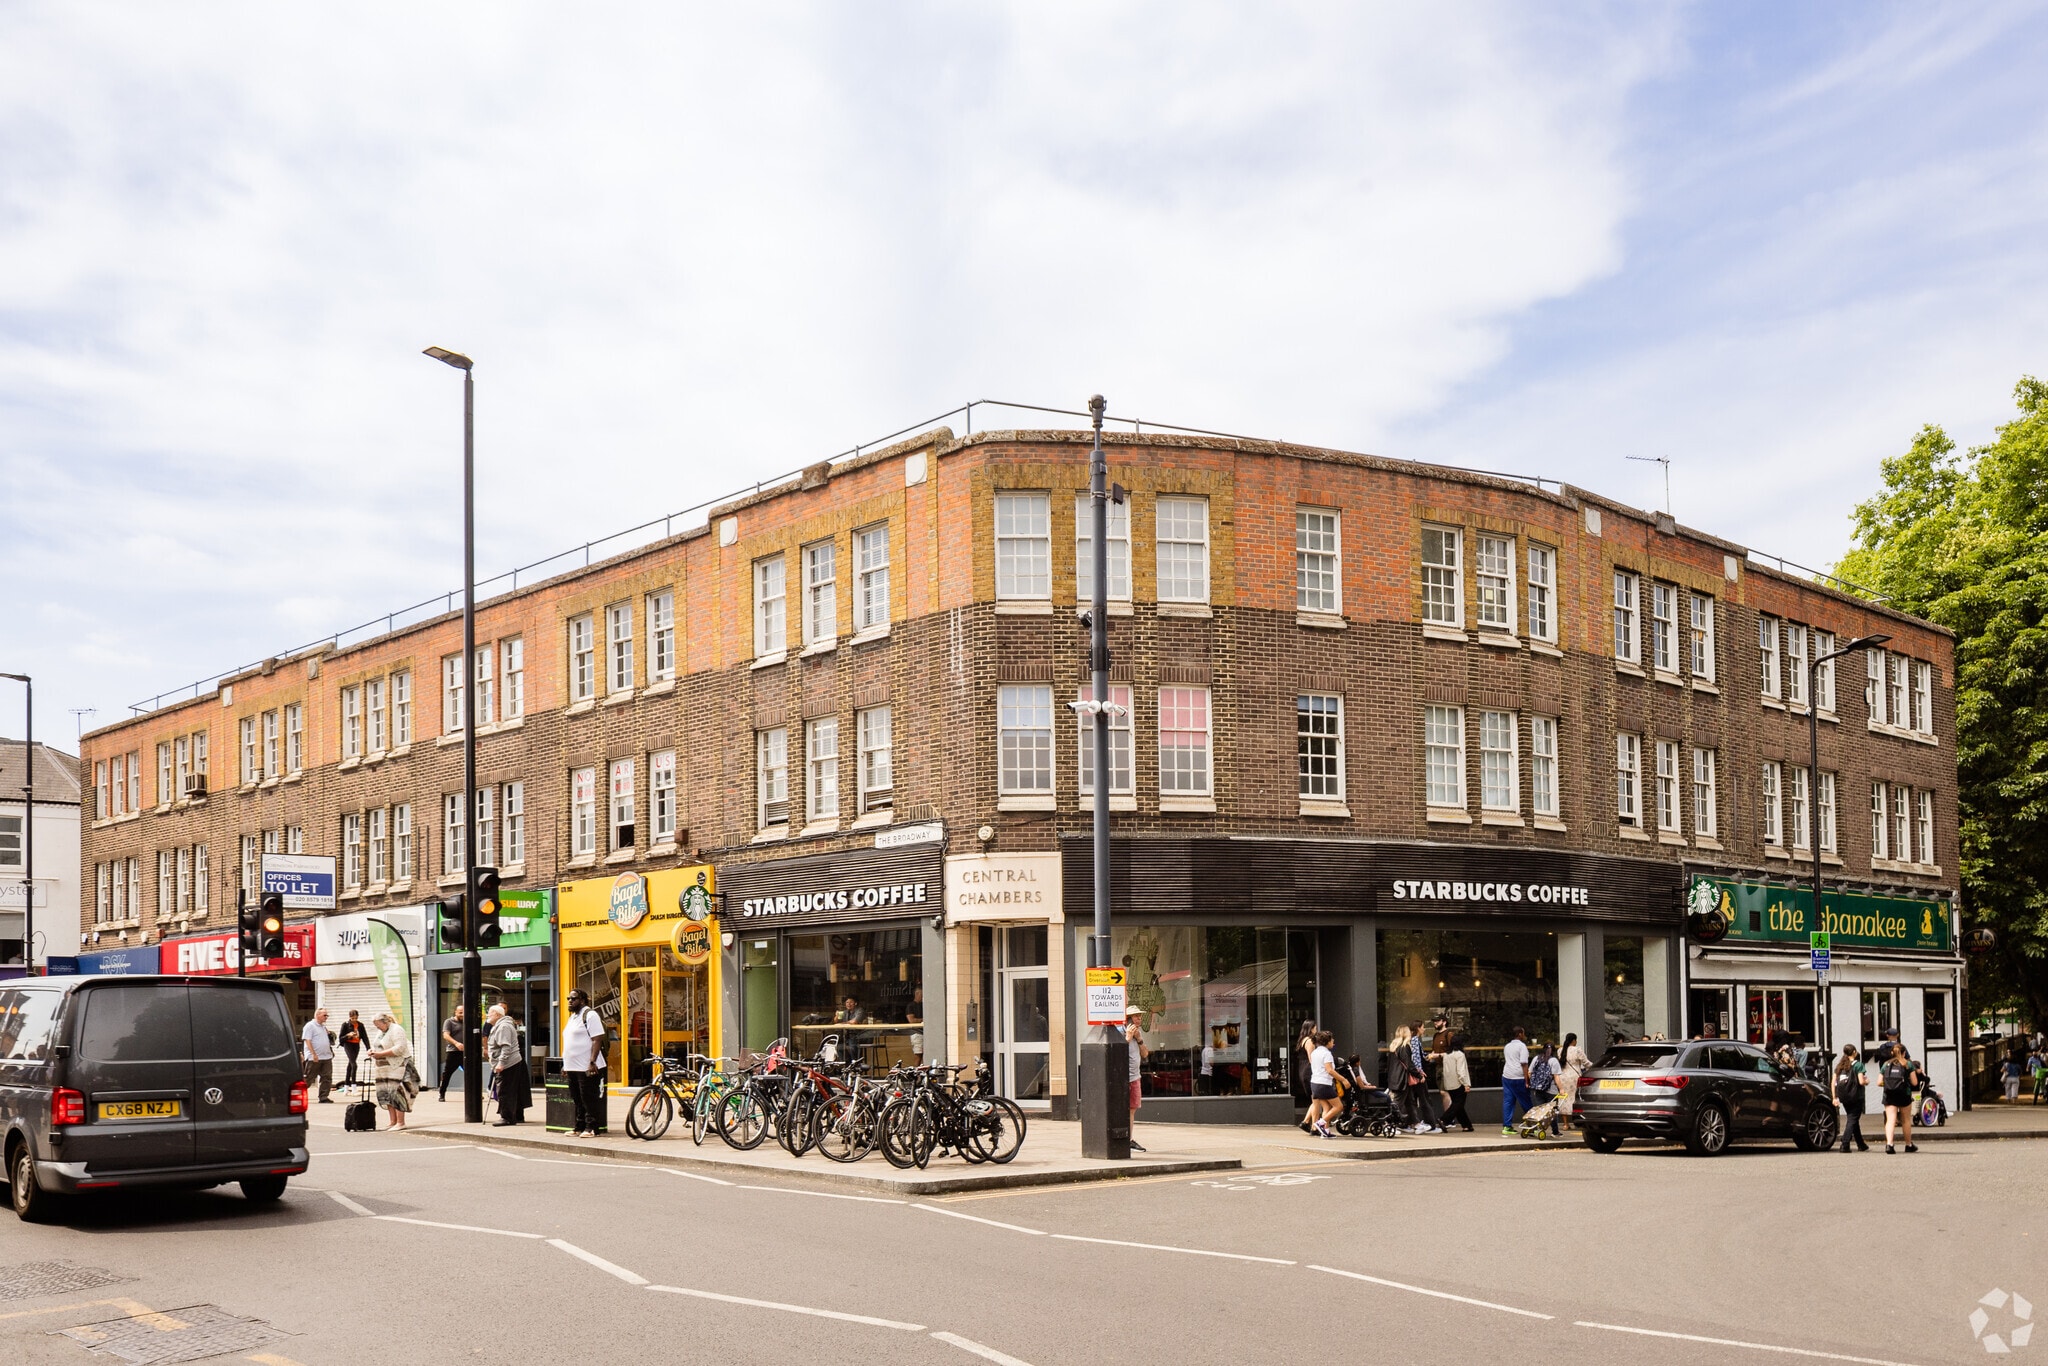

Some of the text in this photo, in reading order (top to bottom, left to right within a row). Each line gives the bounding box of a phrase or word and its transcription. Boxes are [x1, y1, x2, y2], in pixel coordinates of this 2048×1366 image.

[878, 831, 930, 845] THE BROADWAY
[267, 873, 302, 881] OFFICES
[962, 869, 1037, 884] CENTRAL
[267, 881, 320, 894] TO LET
[611, 877, 642, 905] Bagel
[1393, 880, 1589, 905] STARBUCKS COFFEE
[501, 899, 539, 909] SUBWAY
[743, 884, 927, 917] STARBUCKS COFFEE
[959, 891, 1042, 905] CHAMBERS
[616, 903, 640, 923] Bite
[1768, 901, 1804, 931] the
[681, 927, 706, 944] Bagel
[283, 942, 298, 951] VE
[685, 942, 704, 955] Bite
[178, 939, 224, 973] FIVE
[505, 969, 522, 980] Open
[600, 990, 639, 1018] LONON
[106, 1102, 174, 1116] CX68 NZJ
